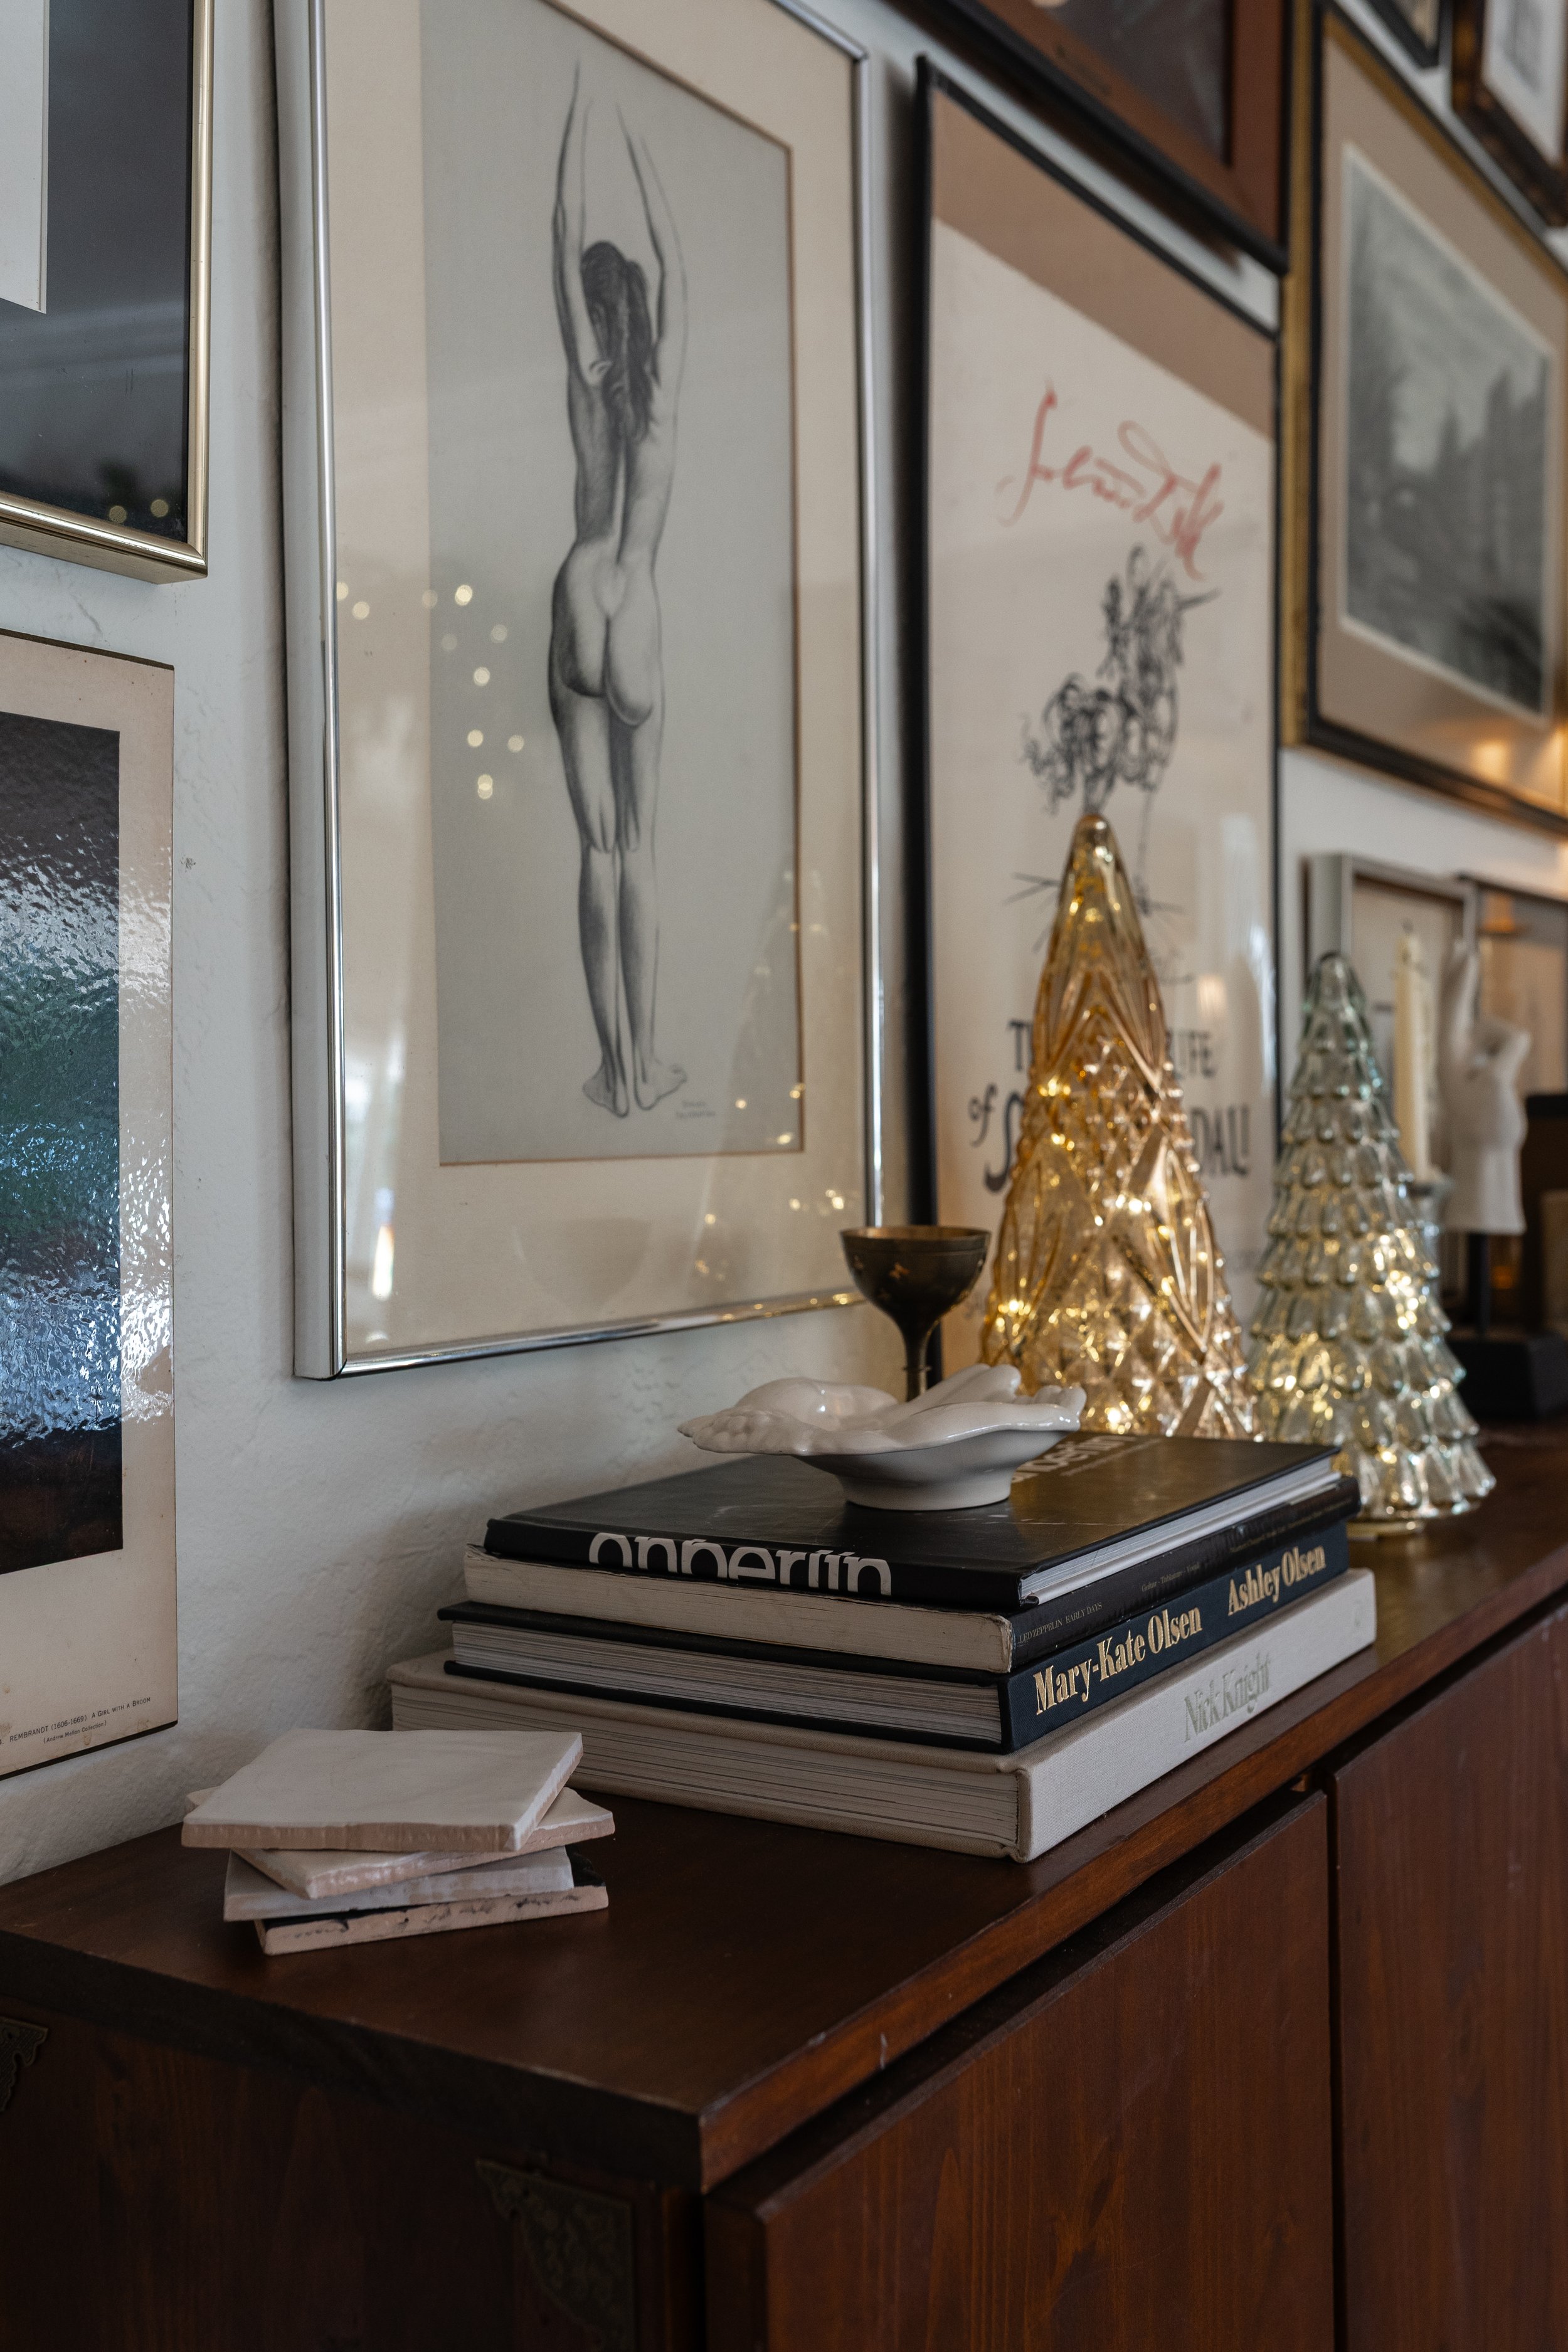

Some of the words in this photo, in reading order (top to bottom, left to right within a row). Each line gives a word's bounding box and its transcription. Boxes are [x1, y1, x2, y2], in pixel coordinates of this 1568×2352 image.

[1032, 1618, 1062, 1638] ZEPPELIN
[1066, 1608, 1085, 1624] EARLY
[1086, 1601, 1103, 1615] DAYS
[1033, 1629, 1146, 1715] Mary-Kate
[1147, 1607, 1202, 1654] Olsen
[1227, 1564, 1281, 1616] Ashley
[1281, 1545, 1327, 1587] Olsen
[9, 1725, 49, 1742] REMBRANDT
[51, 1715, 87, 1731] (1606-1669)
[82, 1720, 107, 1732] Collection)
